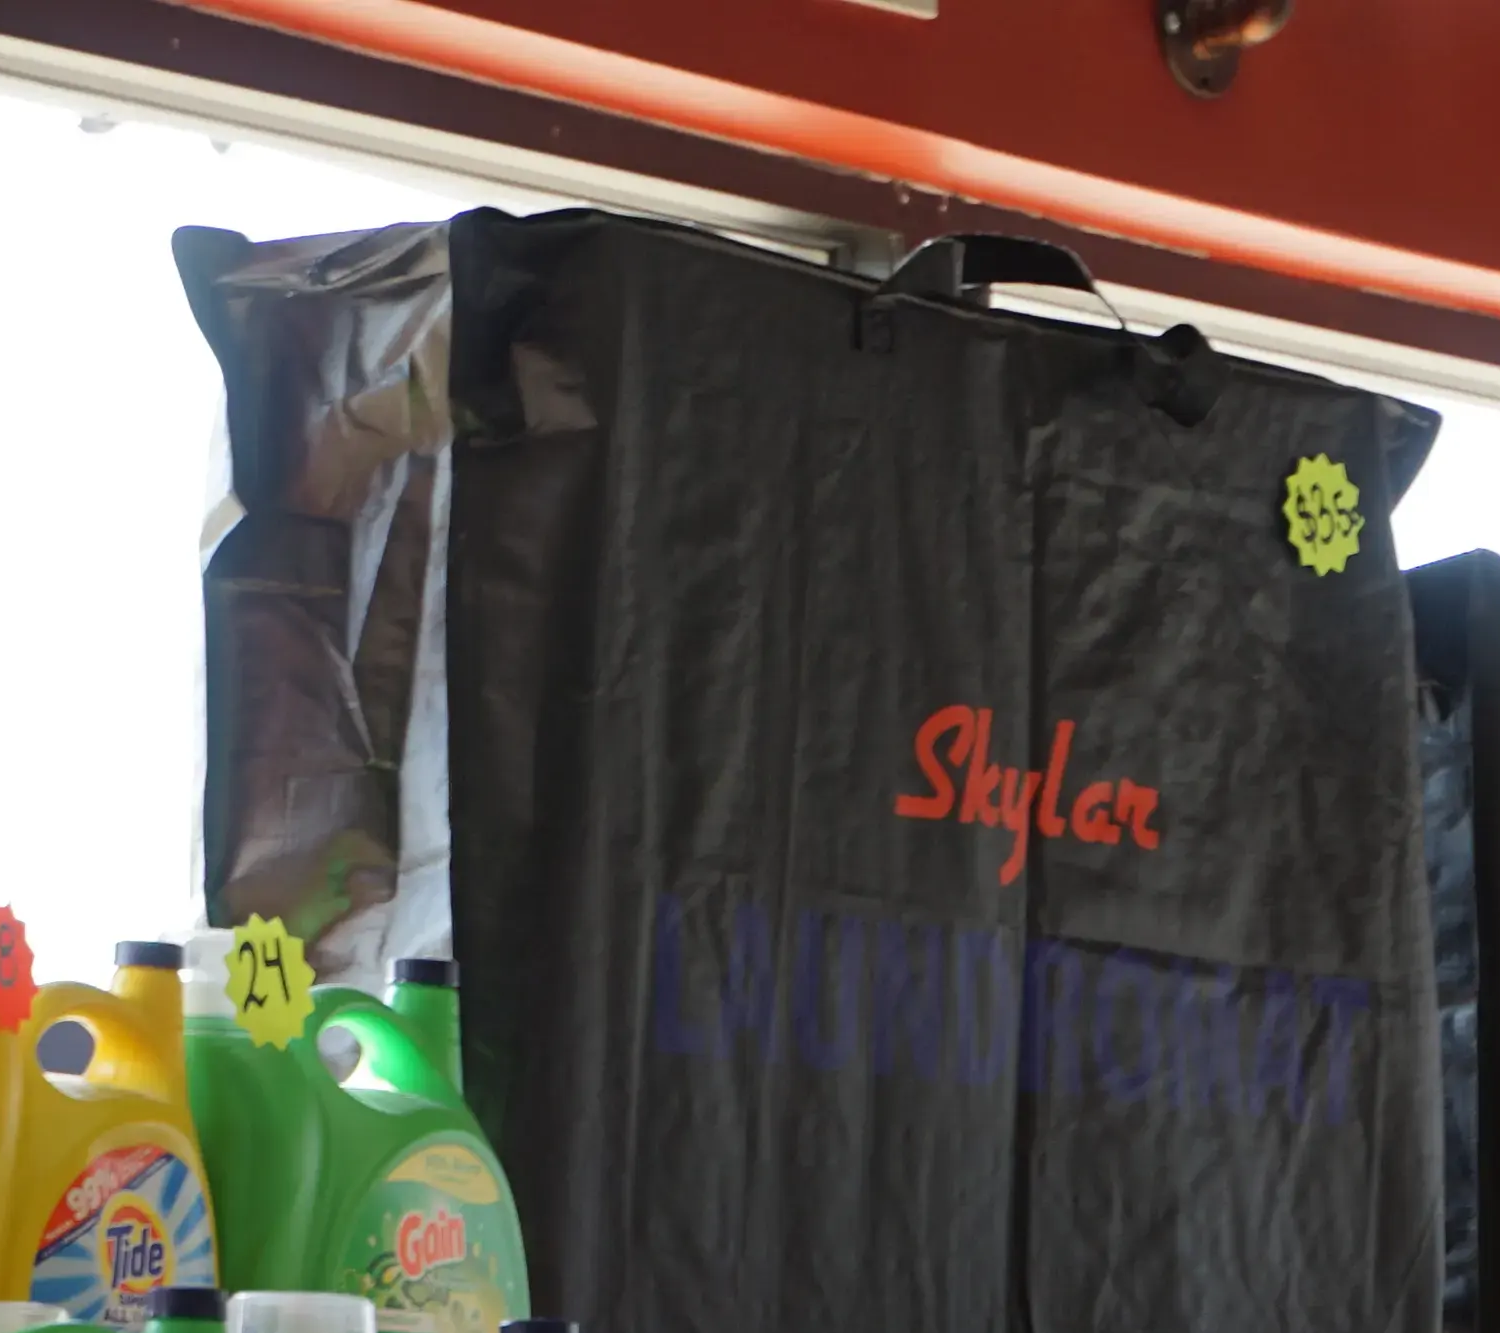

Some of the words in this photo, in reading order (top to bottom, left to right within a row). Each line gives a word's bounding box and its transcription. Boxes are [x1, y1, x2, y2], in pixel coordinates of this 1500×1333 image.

[895, 703, 1160, 886] Skylar
[238, 937, 292, 1014] 24
[652, 894, 1371, 1127] LAUNDROMAT
[107, 1224, 164, 1287] Tide
[398, 1209, 466, 1278] Gain
